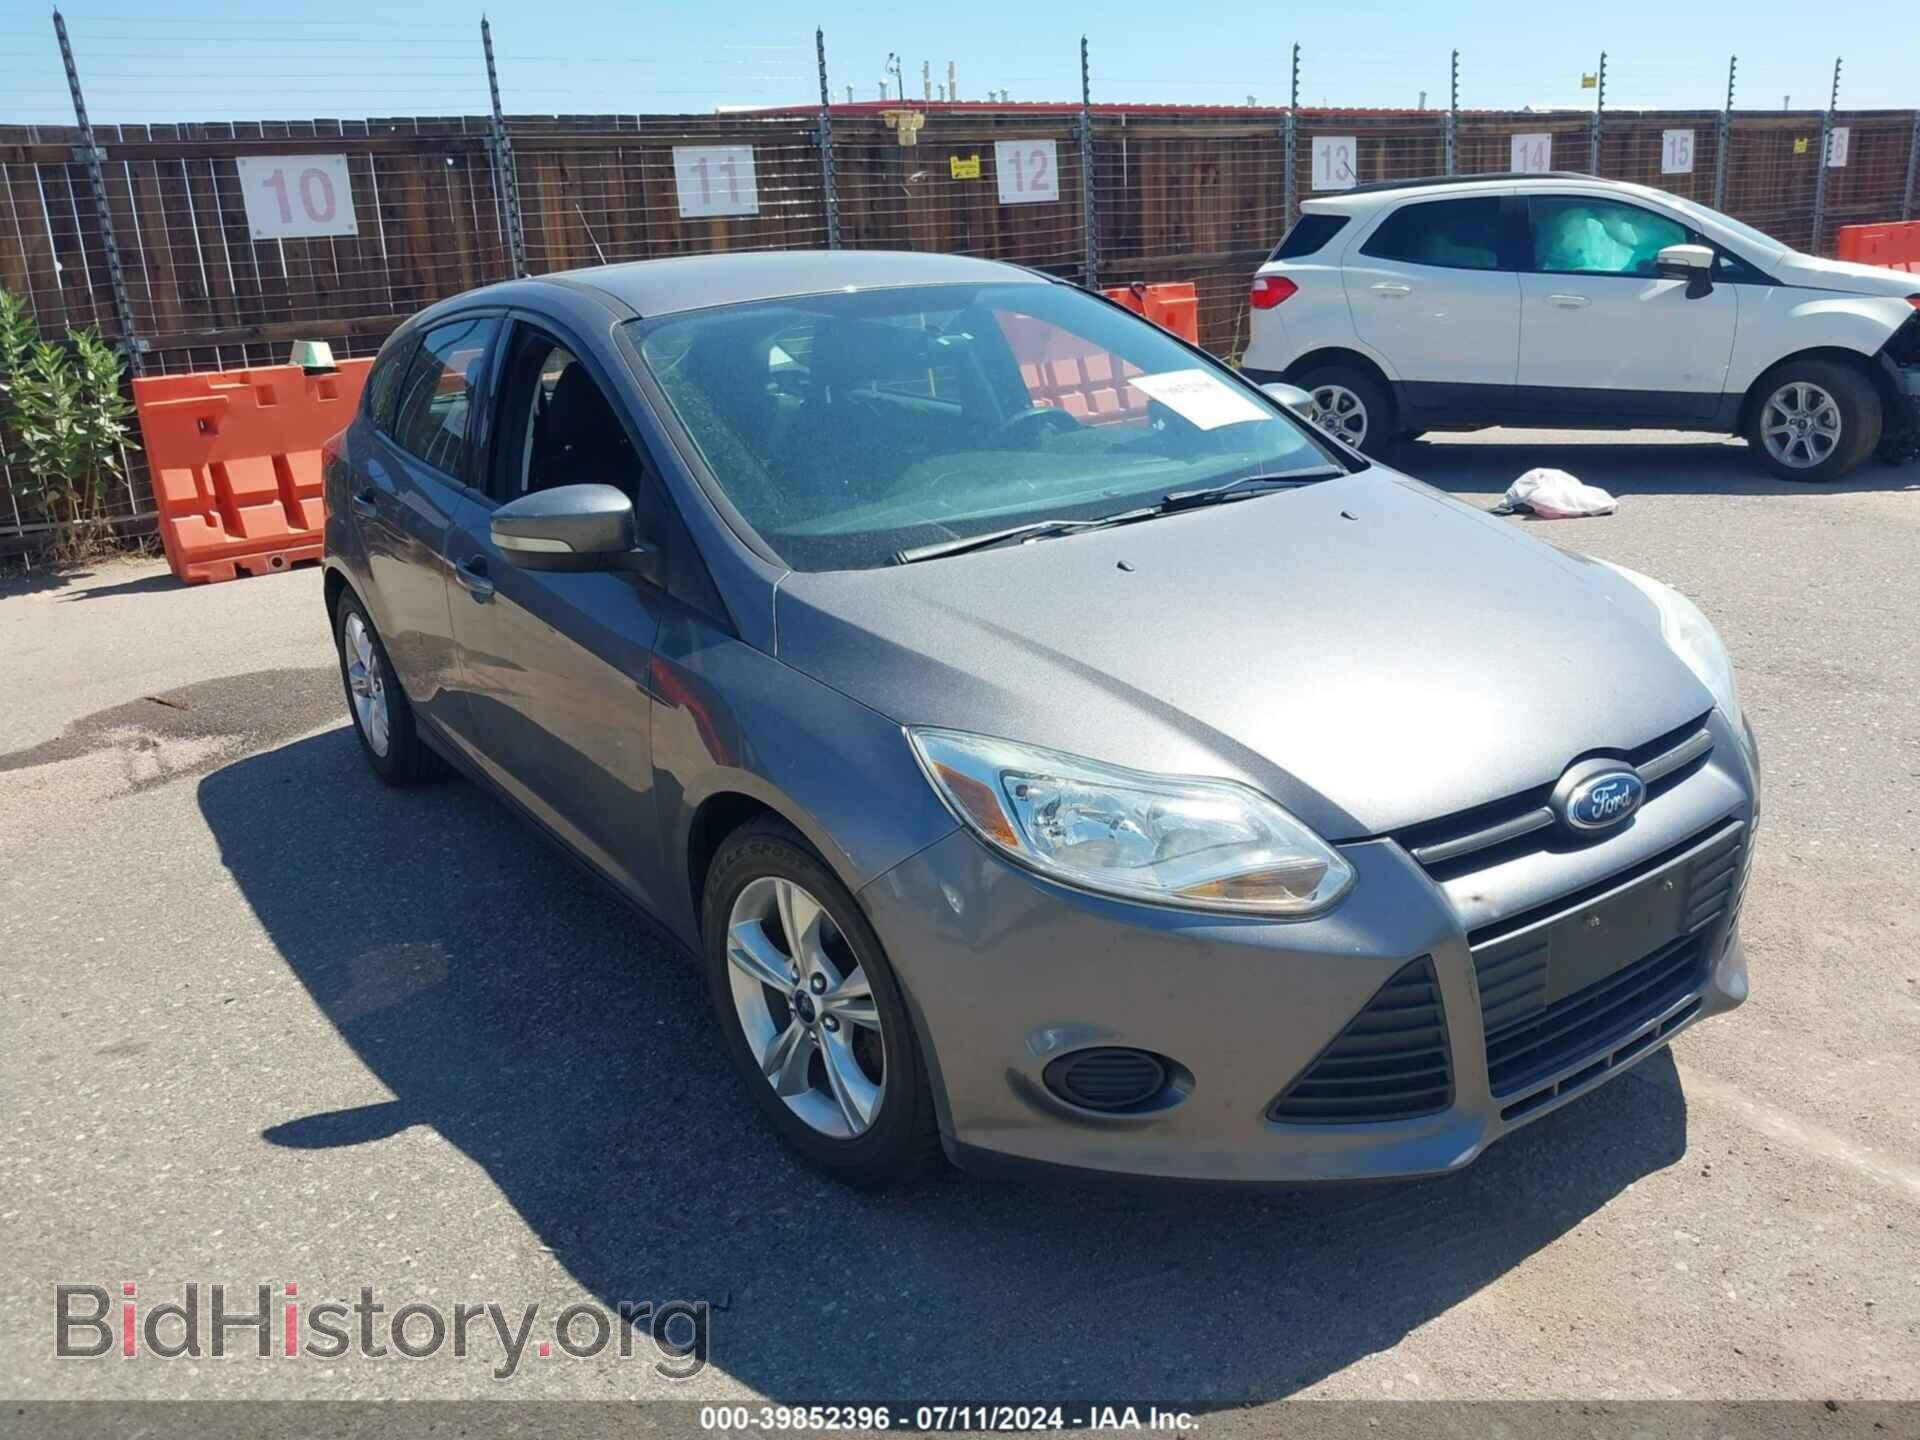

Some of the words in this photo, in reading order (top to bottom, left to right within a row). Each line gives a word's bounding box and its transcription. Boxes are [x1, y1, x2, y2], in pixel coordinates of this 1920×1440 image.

[1320, 144, 1349, 180] 13
[1519, 141, 1546, 172] 14
[1669, 136, 1689, 168] 15
[690, 156, 738, 205] 11
[1008, 150, 1049, 192] 12
[262, 168, 336, 224] 10
[1592, 783, 1632, 819] Ford
